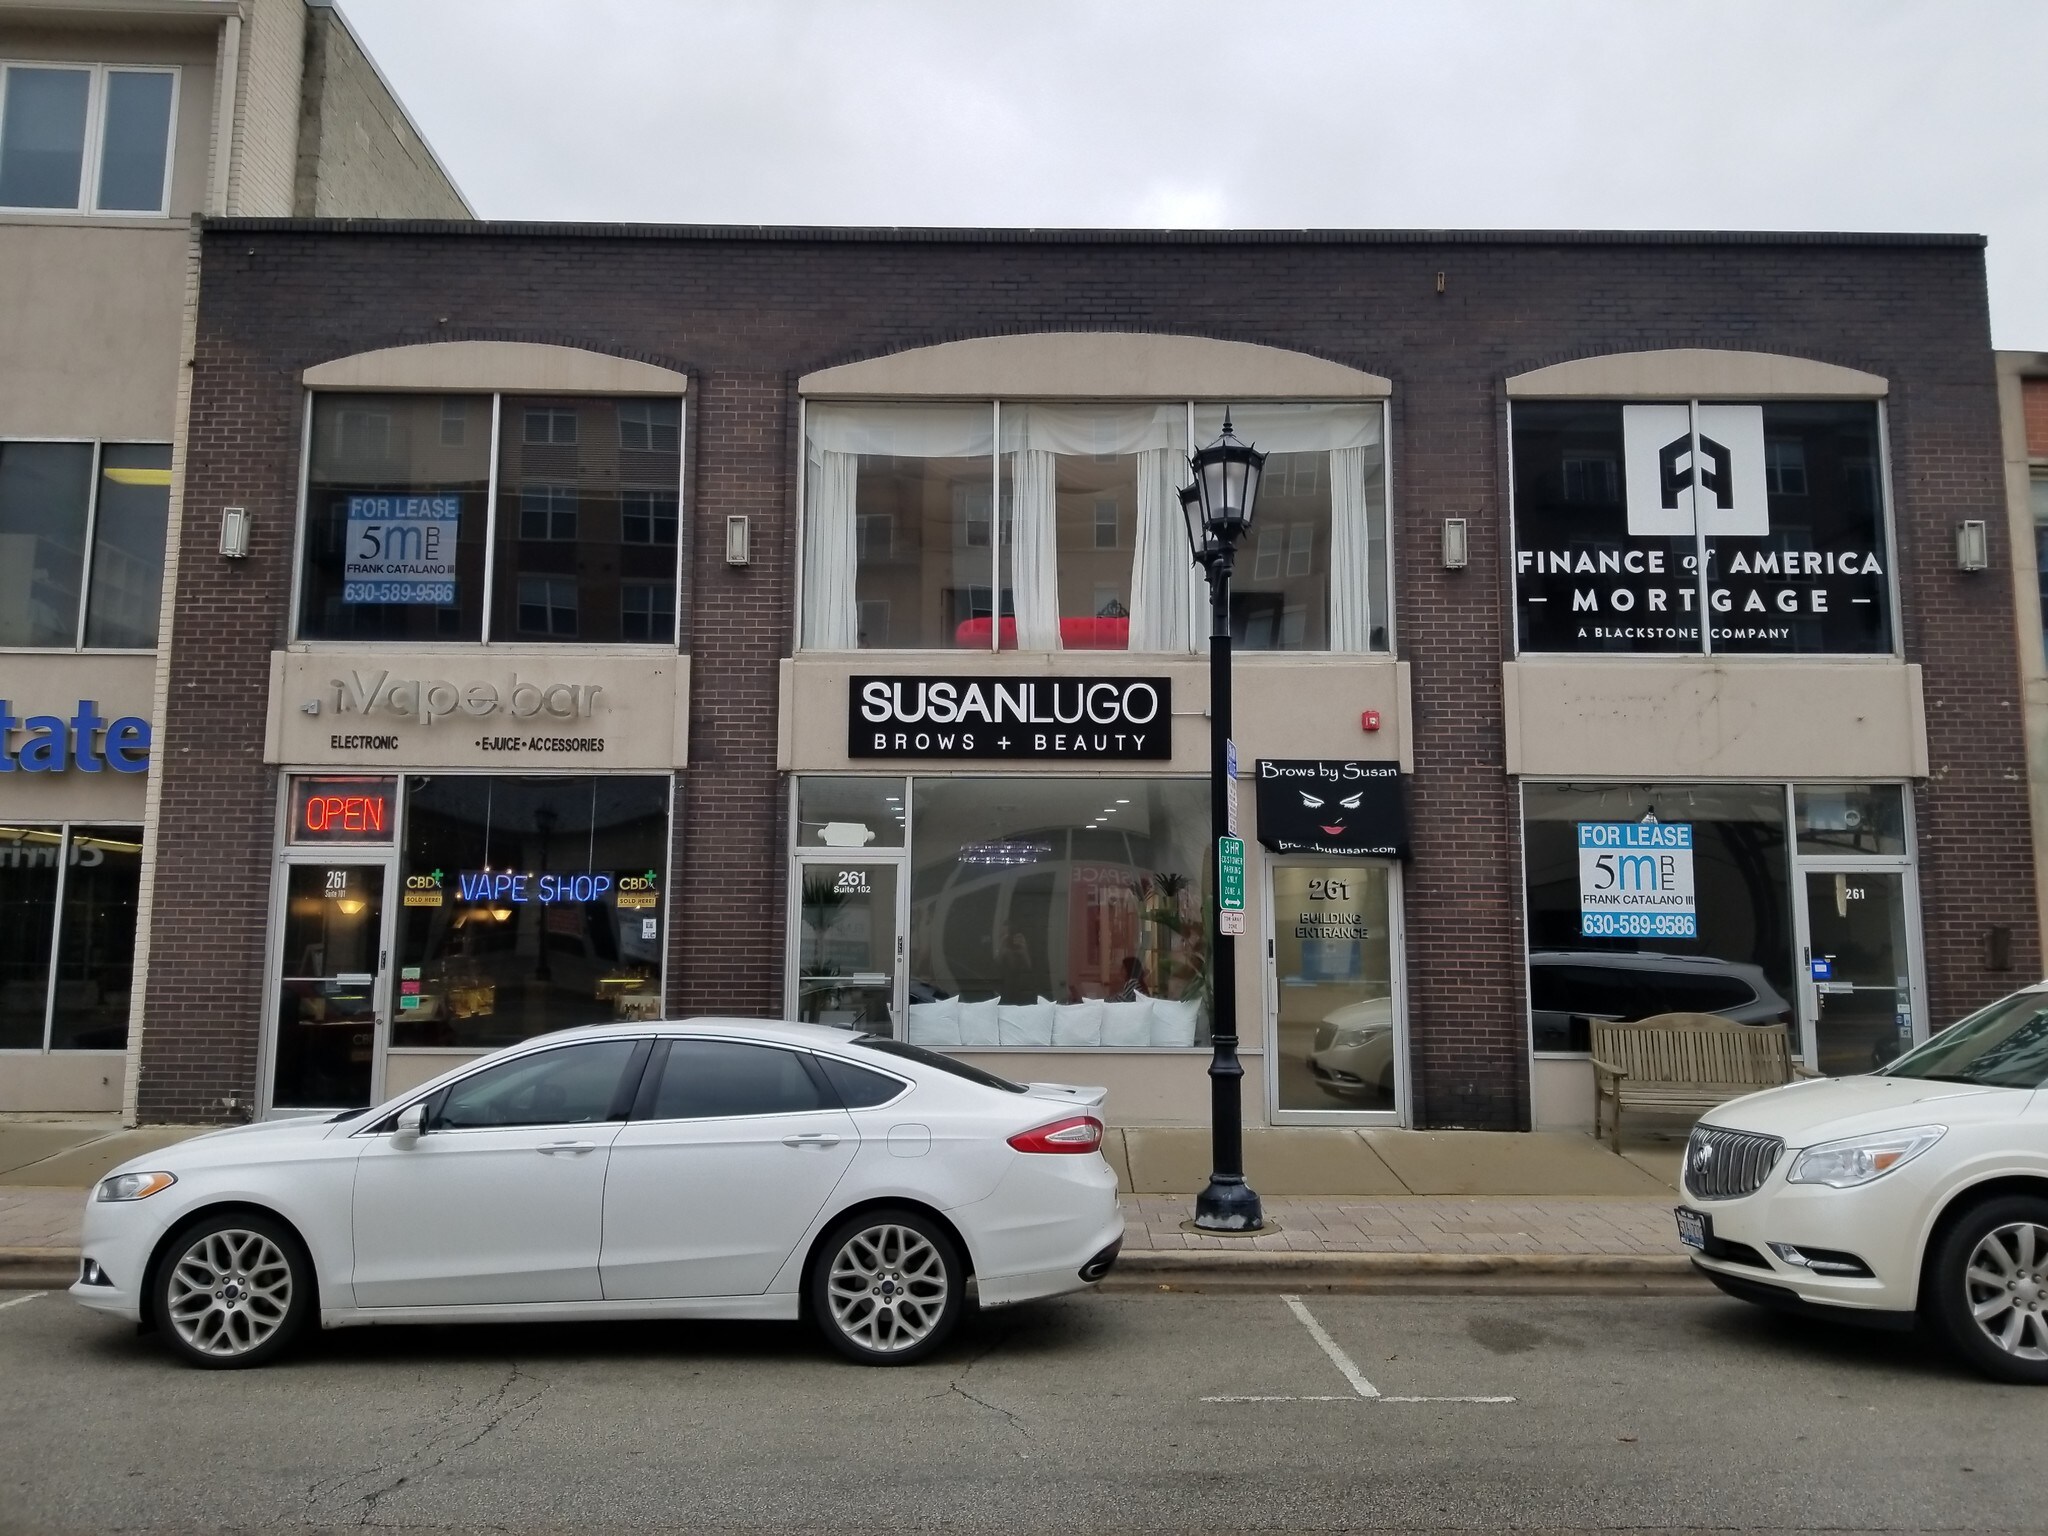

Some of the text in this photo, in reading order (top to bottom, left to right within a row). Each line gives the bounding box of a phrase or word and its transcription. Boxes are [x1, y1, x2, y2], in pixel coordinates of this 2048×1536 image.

[351, 499, 456, 518] FOR LEASE
[346, 564, 384, 574] FRANK
[386, 564, 445, 574] CATALANO
[1517, 549, 1883, 575] FINANCE of AMERICA
[344, 583, 454, 602] 630-589-9586
[1572, 588, 1828, 612] MORTGAGE
[1578, 628, 1789, 639] A BLACKSTONE COMPANY
[331, 735, 398, 749] ELECTRONIC
[528, 738, 604, 752] ACCESSORIES
[874, 733, 1146, 751] BROWS + BEAUTY
[1261, 761, 1397, 781] Brows by Susan
[307, 797, 384, 831] OPEN
[1581, 826, 1690, 846] FOR LEASE
[838, 871, 866, 886] 261
[1224, 865, 1241, 875] PARKING
[326, 871, 346, 889] 261
[461, 873, 610, 902] VAPE SHOP
[1227, 875, 1238, 884] ONLY
[833, 885, 871, 893] Suite 102
[1224, 886, 1235, 895] ZONE
[1309, 878, 1350, 901] 261
[1845, 888, 1865, 900] 261
[1583, 894, 1694, 905] FRANK CATALANO III
[1300, 912, 1362, 925] BUILDING
[1583, 914, 1695, 935] 630-589-9586
[1295, 927, 1368, 939] ENTRANCE
